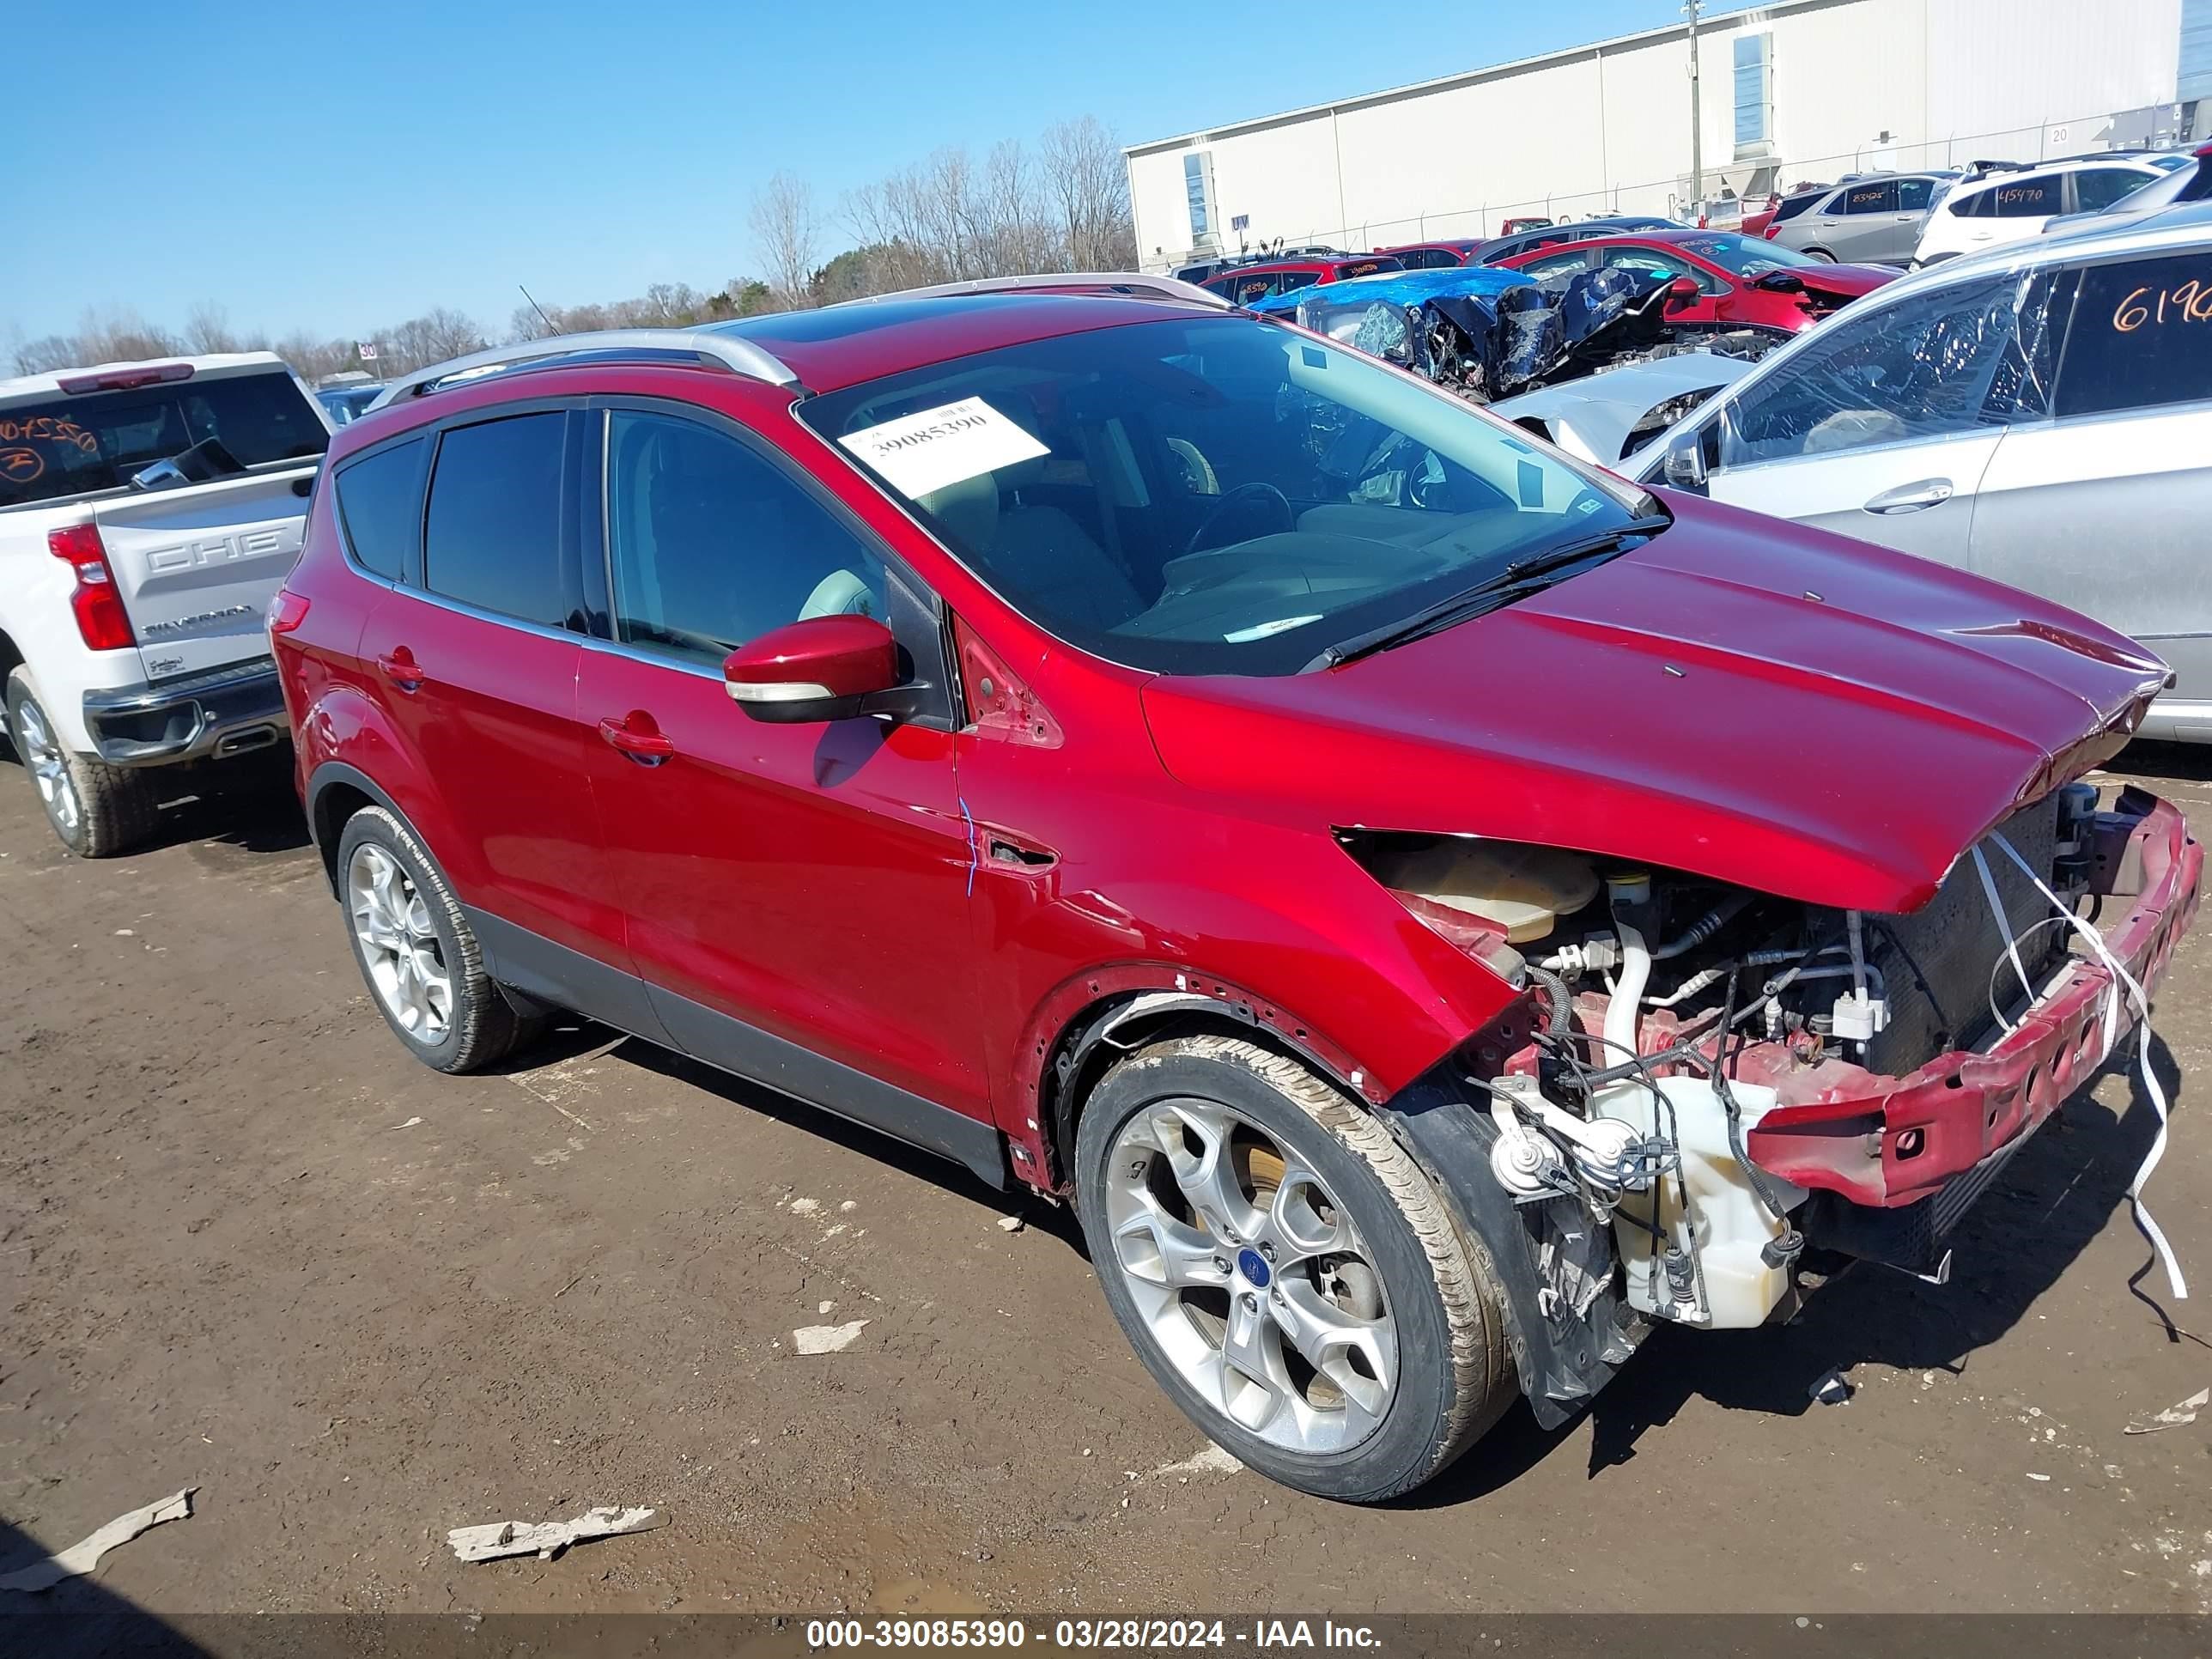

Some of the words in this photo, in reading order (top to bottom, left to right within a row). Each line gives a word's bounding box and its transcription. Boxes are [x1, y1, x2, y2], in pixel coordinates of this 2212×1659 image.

[2052, 129, 2067, 142] 20
[1999, 188, 2043, 204] 45470
[361, 343, 375, 357] 30
[872, 415, 988, 457] 39085390
